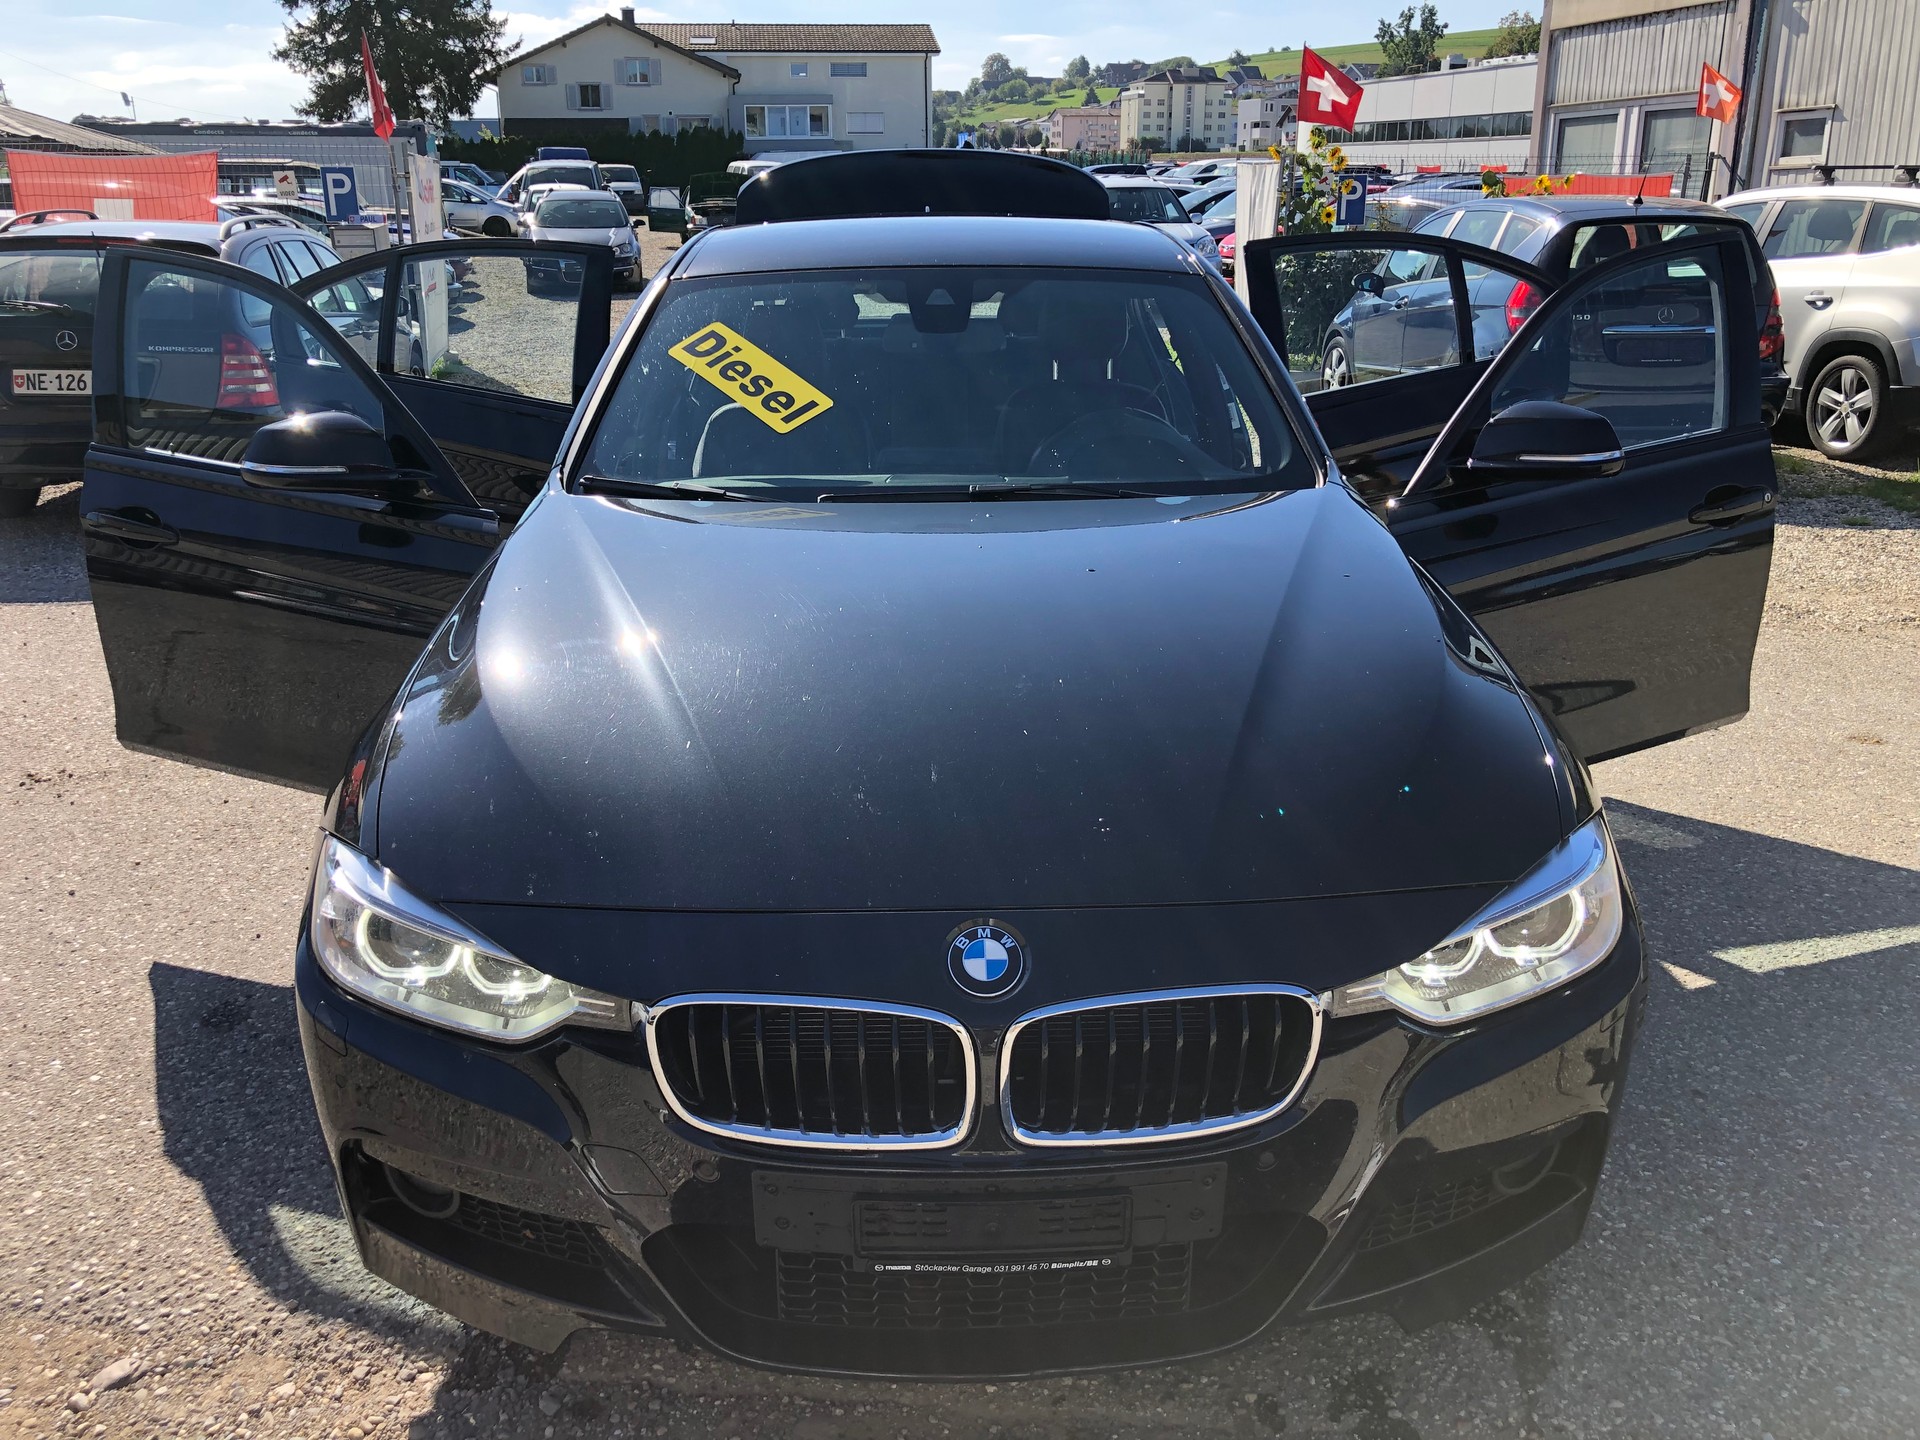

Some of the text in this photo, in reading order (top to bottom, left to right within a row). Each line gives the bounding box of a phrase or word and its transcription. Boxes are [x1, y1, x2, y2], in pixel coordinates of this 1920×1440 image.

[325, 172, 352, 216] P
[1340, 180, 1363, 220] P
[360, 215, 377, 223] PAUL
[148, 345, 214, 353] KOMPRESSOR
[681, 329, 820, 424] Diesel
[955, 928, 1016, 950] BMW
[914, 1264, 960, 1272] Stöckacker
[962, 1264, 992, 1273] Garage
[1010, 1264, 1025, 1272] 991
[1027, 1263, 1037, 1271] 45
[1039, 1262, 1049, 1270] 70
